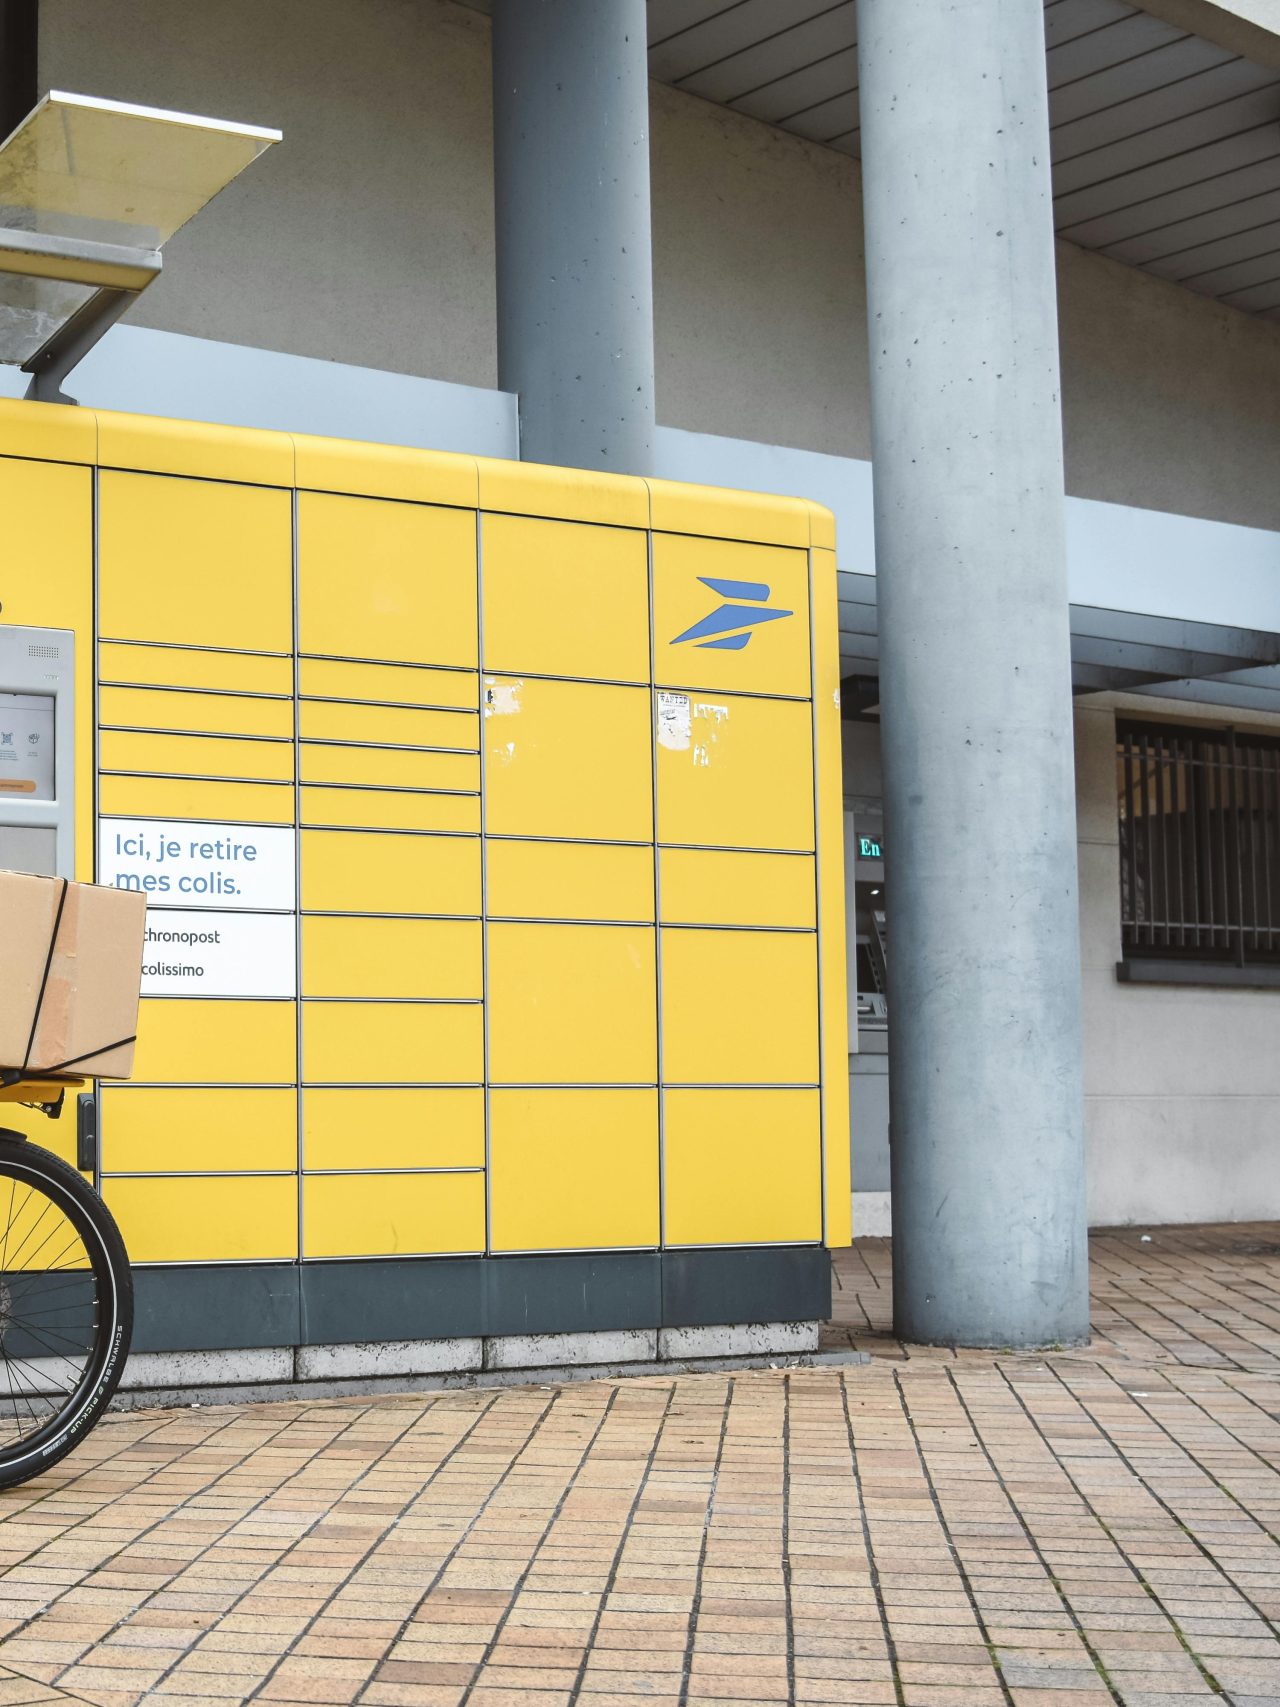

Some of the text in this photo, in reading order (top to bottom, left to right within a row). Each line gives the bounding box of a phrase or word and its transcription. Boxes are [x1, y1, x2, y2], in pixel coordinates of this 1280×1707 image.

[116, 833, 257, 862] Ici, je retire
[116, 871, 241, 894] mes colis.
[143, 928, 220, 946] chronopost
[141, 962, 204, 976] colissimo
[70, 1325, 123, 1434] SCHWALBE PICK-UP
